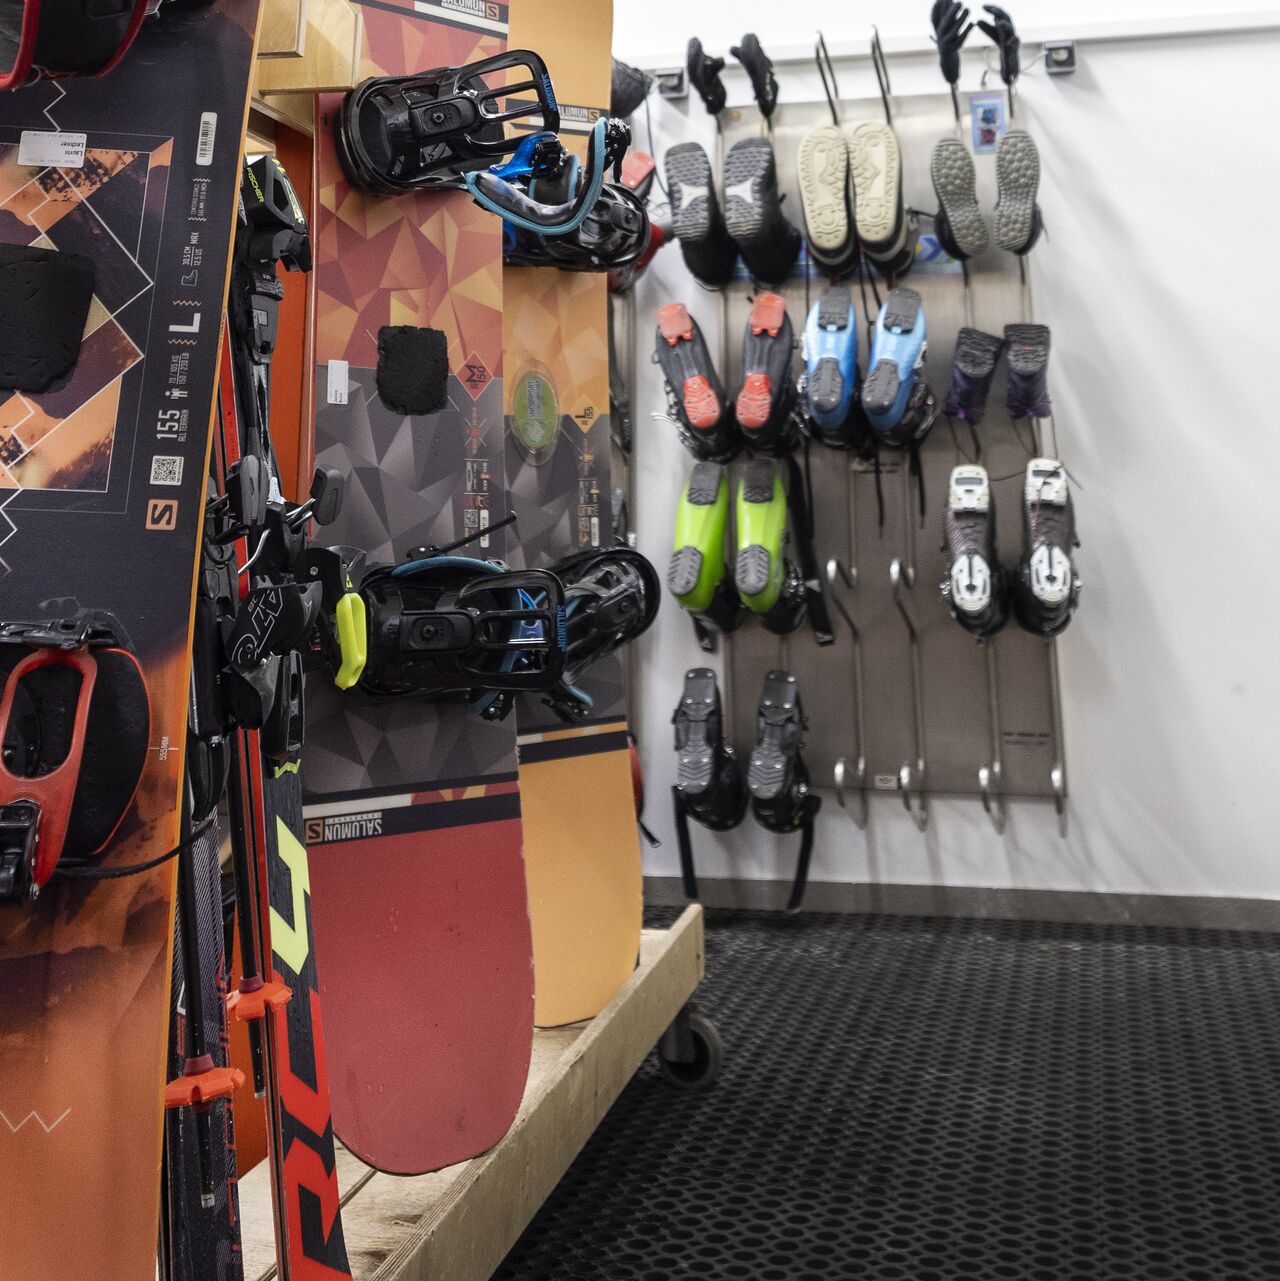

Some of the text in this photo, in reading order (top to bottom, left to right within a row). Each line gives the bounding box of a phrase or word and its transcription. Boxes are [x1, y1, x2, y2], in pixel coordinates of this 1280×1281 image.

[246, 167, 265, 203] FISCHER
[189, 232, 200, 244] MAX
[168, 312, 201, 333] L
[465, 364, 477, 383] M
[477, 365, 486, 384] 150
[156, 409, 180, 440] 155
[177, 409, 189, 442] ALL TERRAIN
[324, 819, 382, 841] SALOMON
